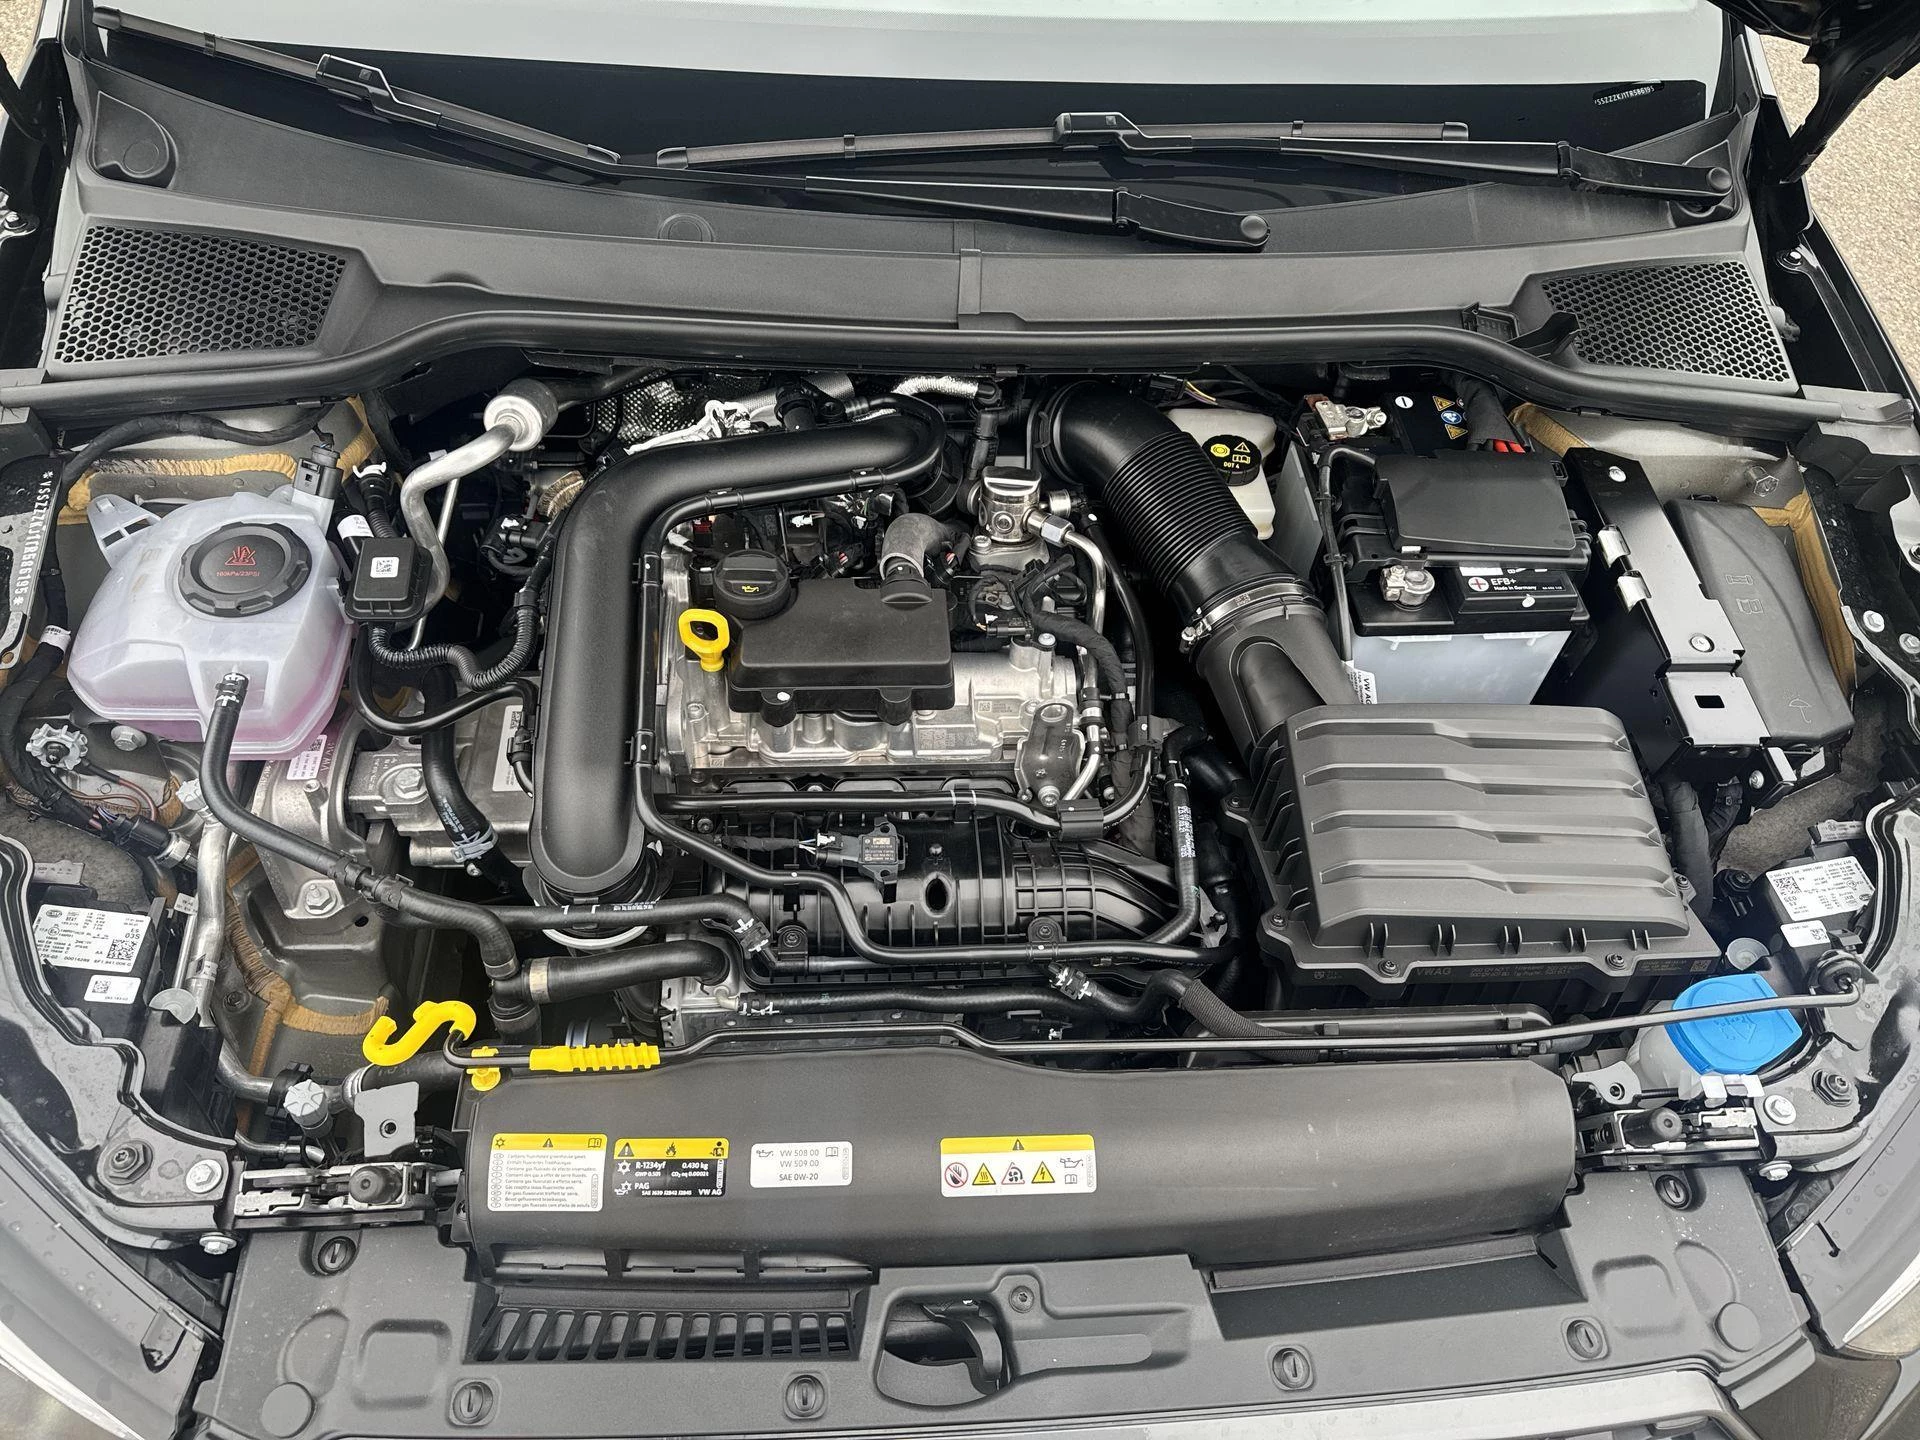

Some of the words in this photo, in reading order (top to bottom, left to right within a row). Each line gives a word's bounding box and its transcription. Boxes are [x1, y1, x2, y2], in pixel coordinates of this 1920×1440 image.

[1490, 577, 1517, 586] EFB+
[779, 1149, 793, 1157] VW
[794, 1149, 808, 1157] 508
[809, 1149, 820, 1157] 00
[635, 1161, 667, 1171] R-1234yf
[700, 1162, 709, 1171] kg
[779, 1160, 793, 1168] VW
[794, 1160, 808, 1168] 509
[809, 1159, 820, 1167] 00
[779, 1173, 793, 1181] SAE
[793, 1172, 819, 1181] 0W-20
[634, 1182, 650, 1190] PAG
[698, 1188, 711, 1196] VW
[711, 1188, 722, 1196] AG
